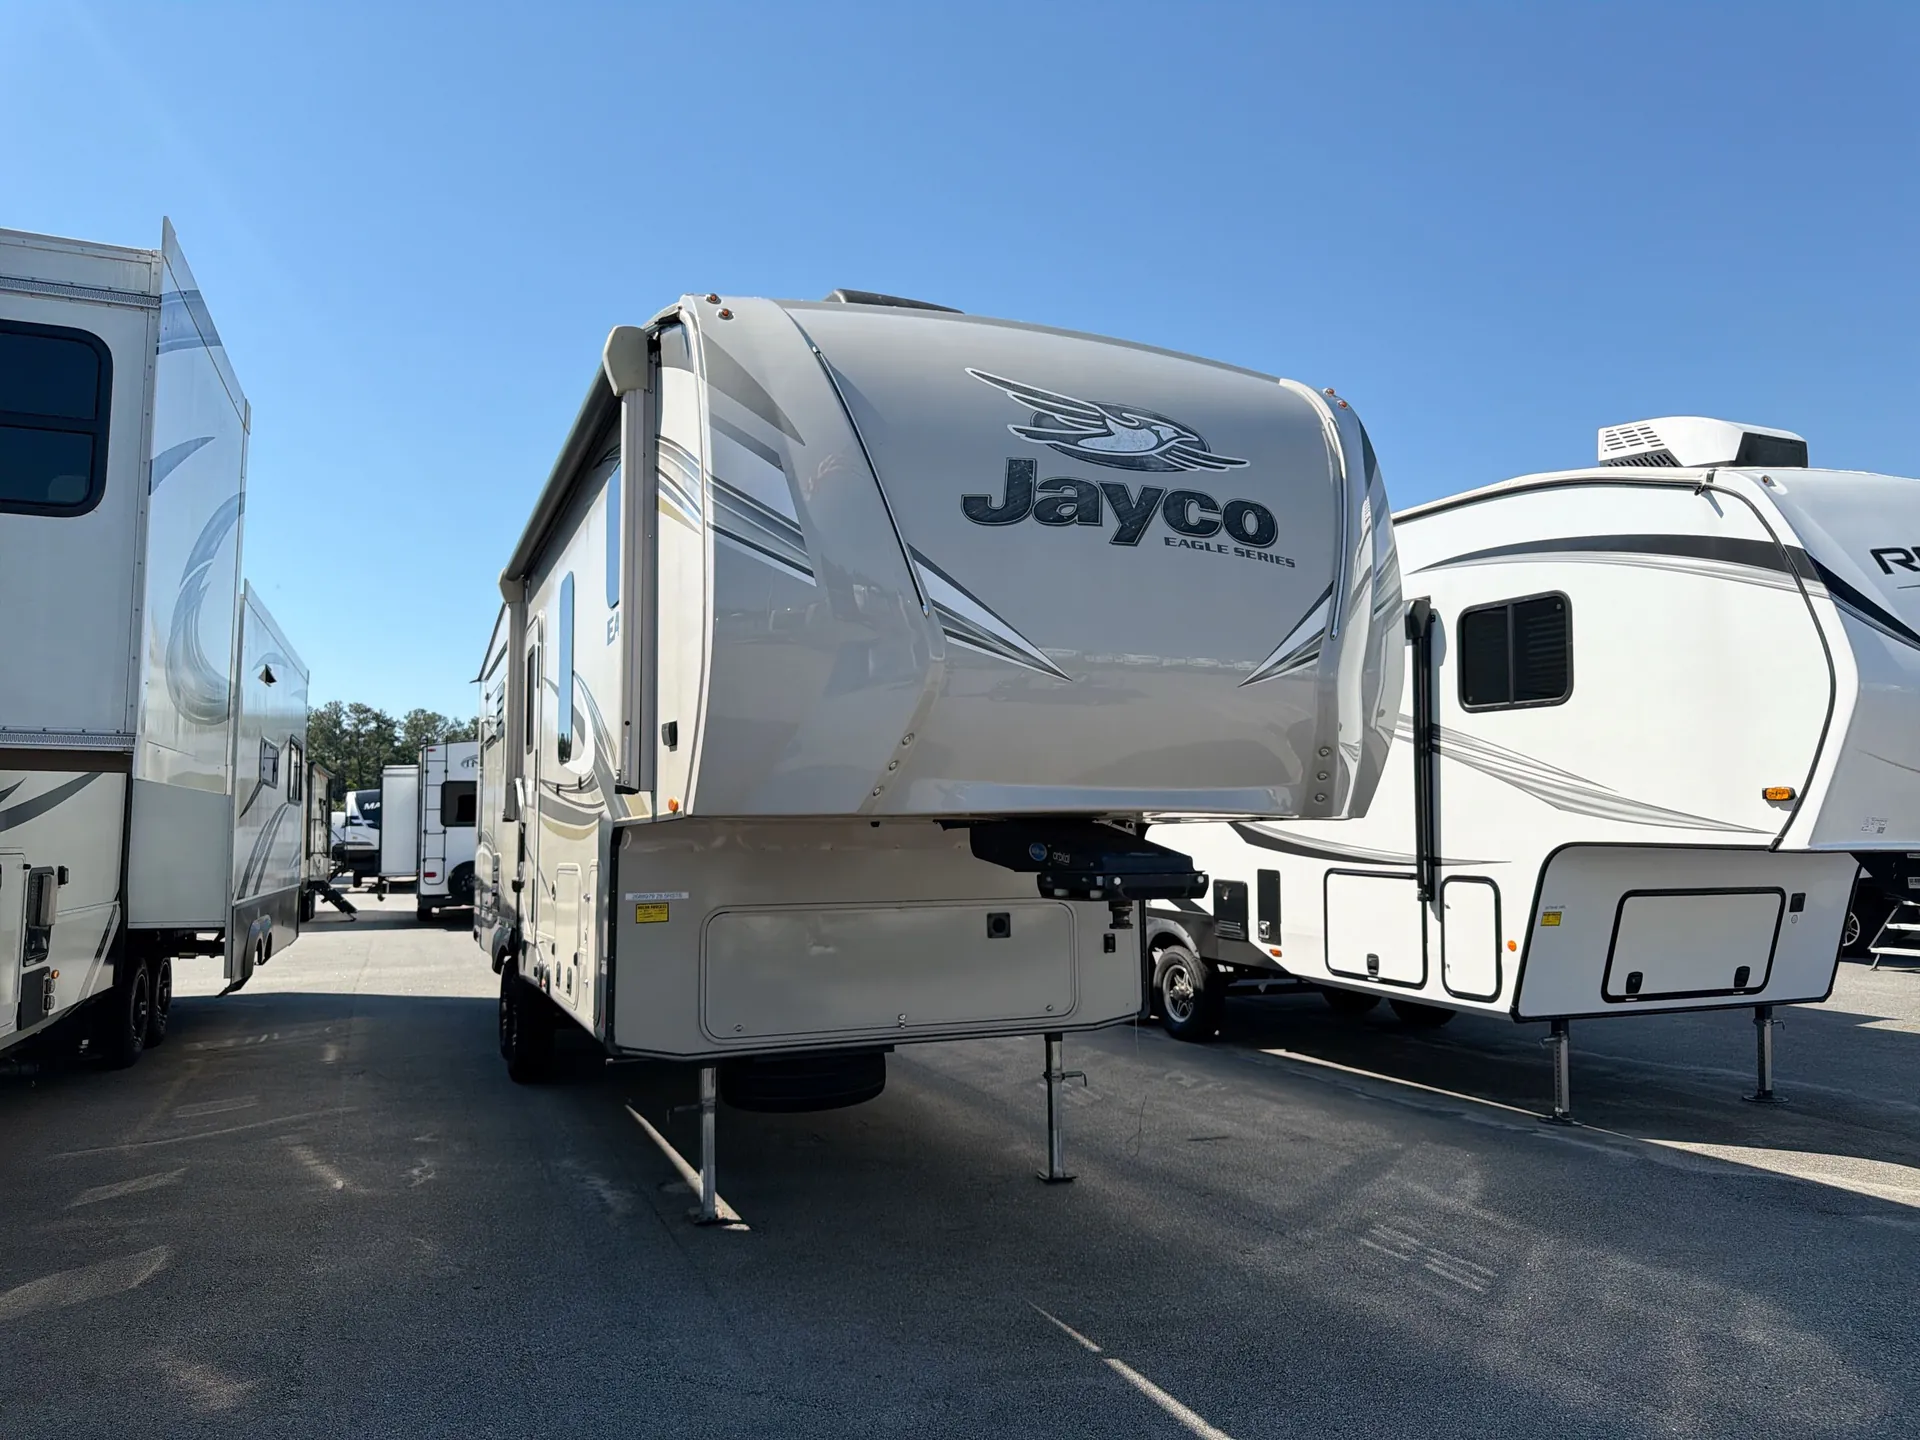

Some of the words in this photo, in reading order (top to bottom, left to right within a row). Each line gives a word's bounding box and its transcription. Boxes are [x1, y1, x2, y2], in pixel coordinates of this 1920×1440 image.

[961, 457, 1279, 548] Jayco
[1164, 537, 1229, 555] EAGLE
[1234, 547, 1296, 569] SERIES
[1869, 546, 1920, 575] R
